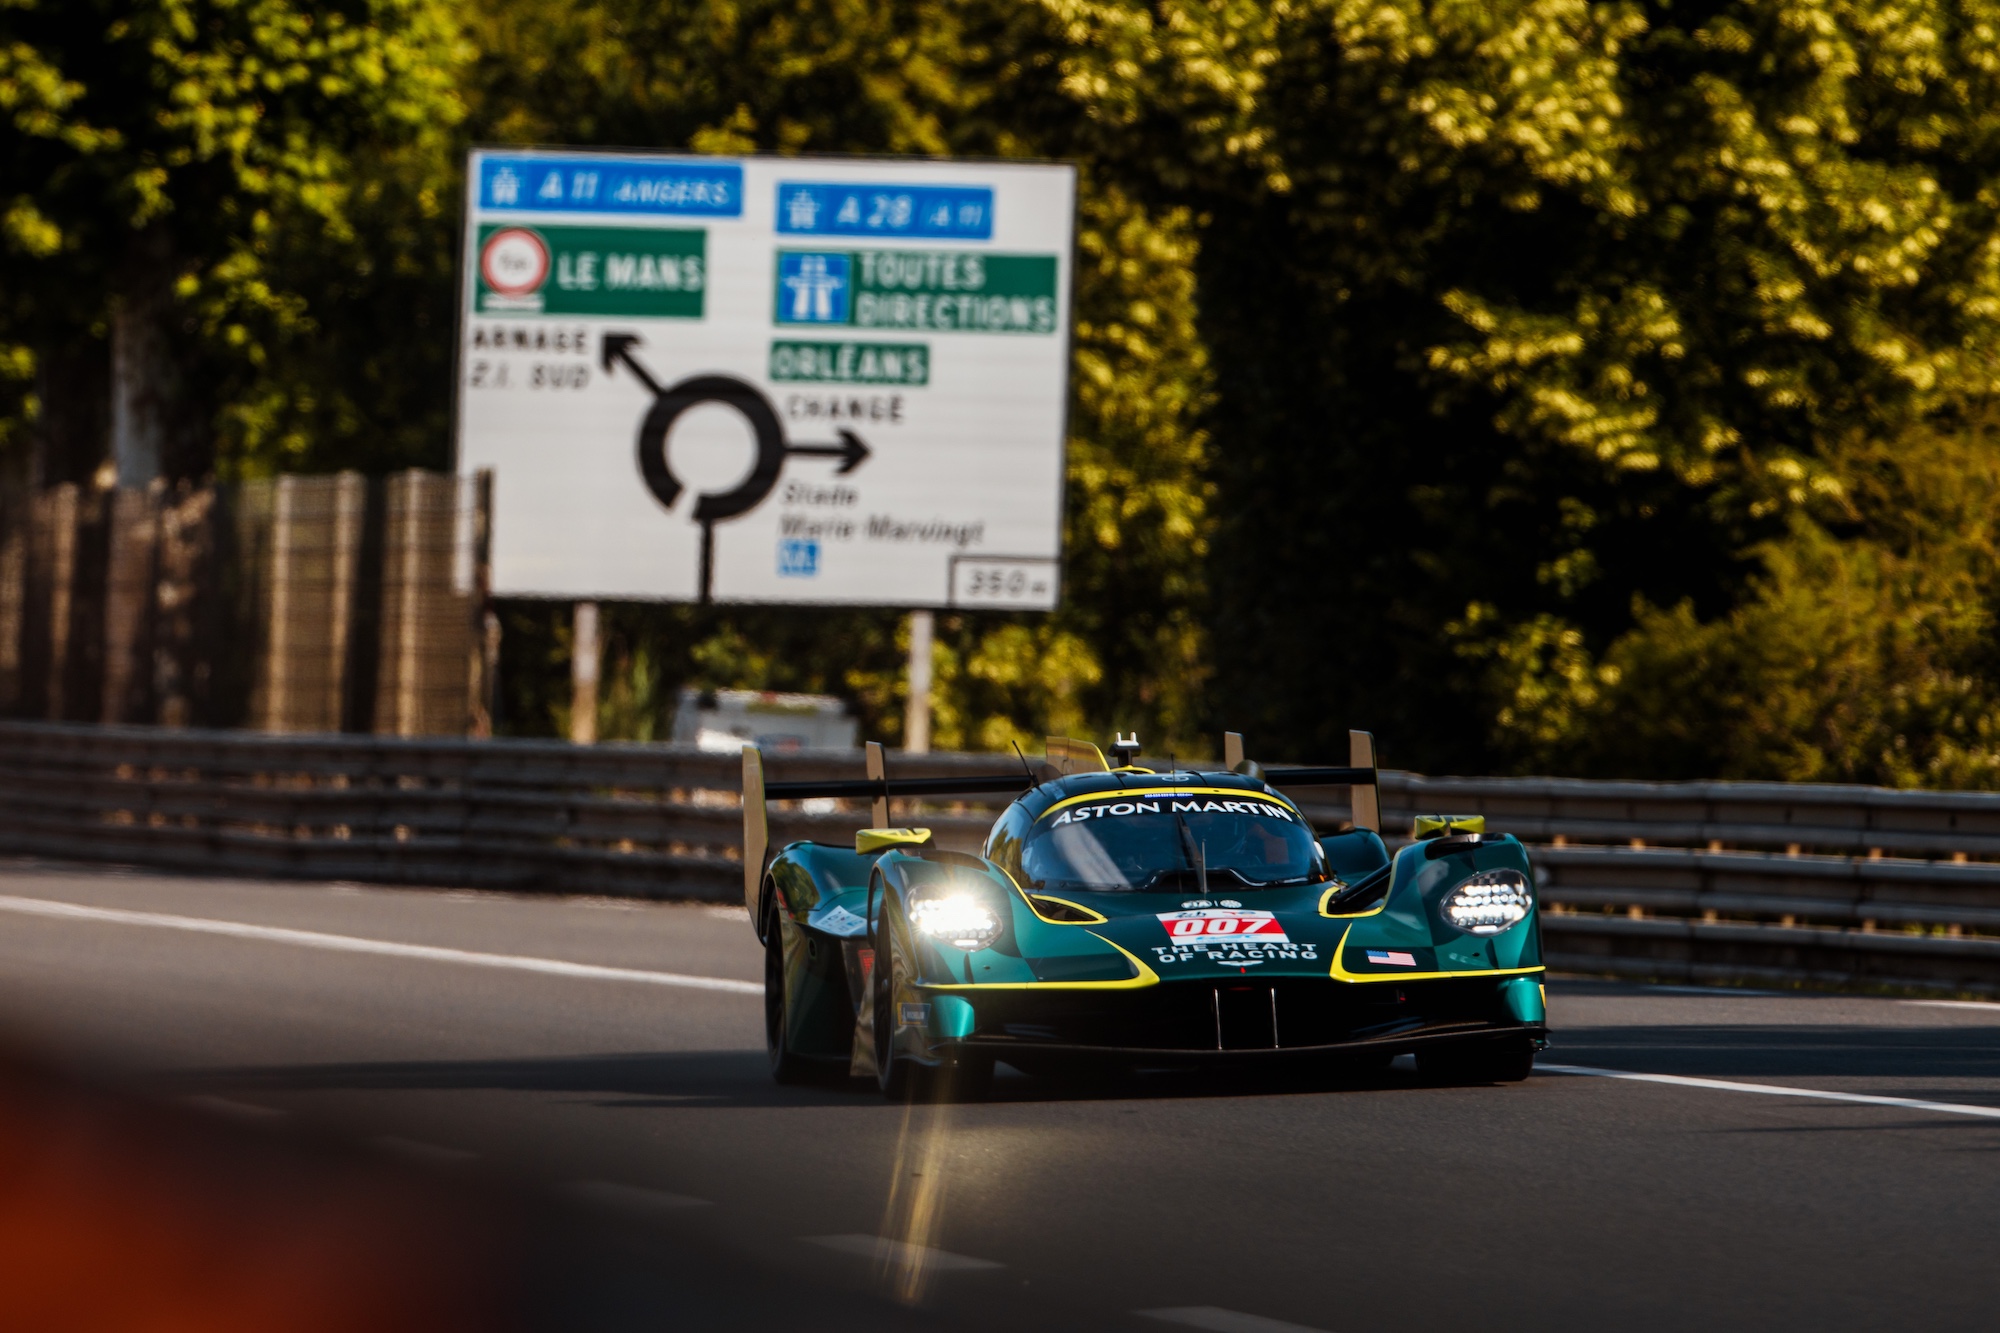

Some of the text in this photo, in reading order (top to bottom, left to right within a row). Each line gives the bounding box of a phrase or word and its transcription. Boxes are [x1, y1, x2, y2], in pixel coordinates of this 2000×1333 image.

[538, 169, 563, 200] A
[836, 195, 860, 224] A
[557, 252, 599, 290] LE
[604, 252, 705, 292] MANS
[859, 251, 986, 289] TOUTES
[856, 292, 1055, 331] DIRECTIONS
[472, 328, 588, 353] ARNAGE
[967, 569, 1026, 595] 350
[1051, 800, 1293, 828] ASTON MARTIN
[1173, 918, 1272, 936] 007
[1151, 943, 1317, 955] THE HEART
[1159, 950, 1318, 963] OF RACING
